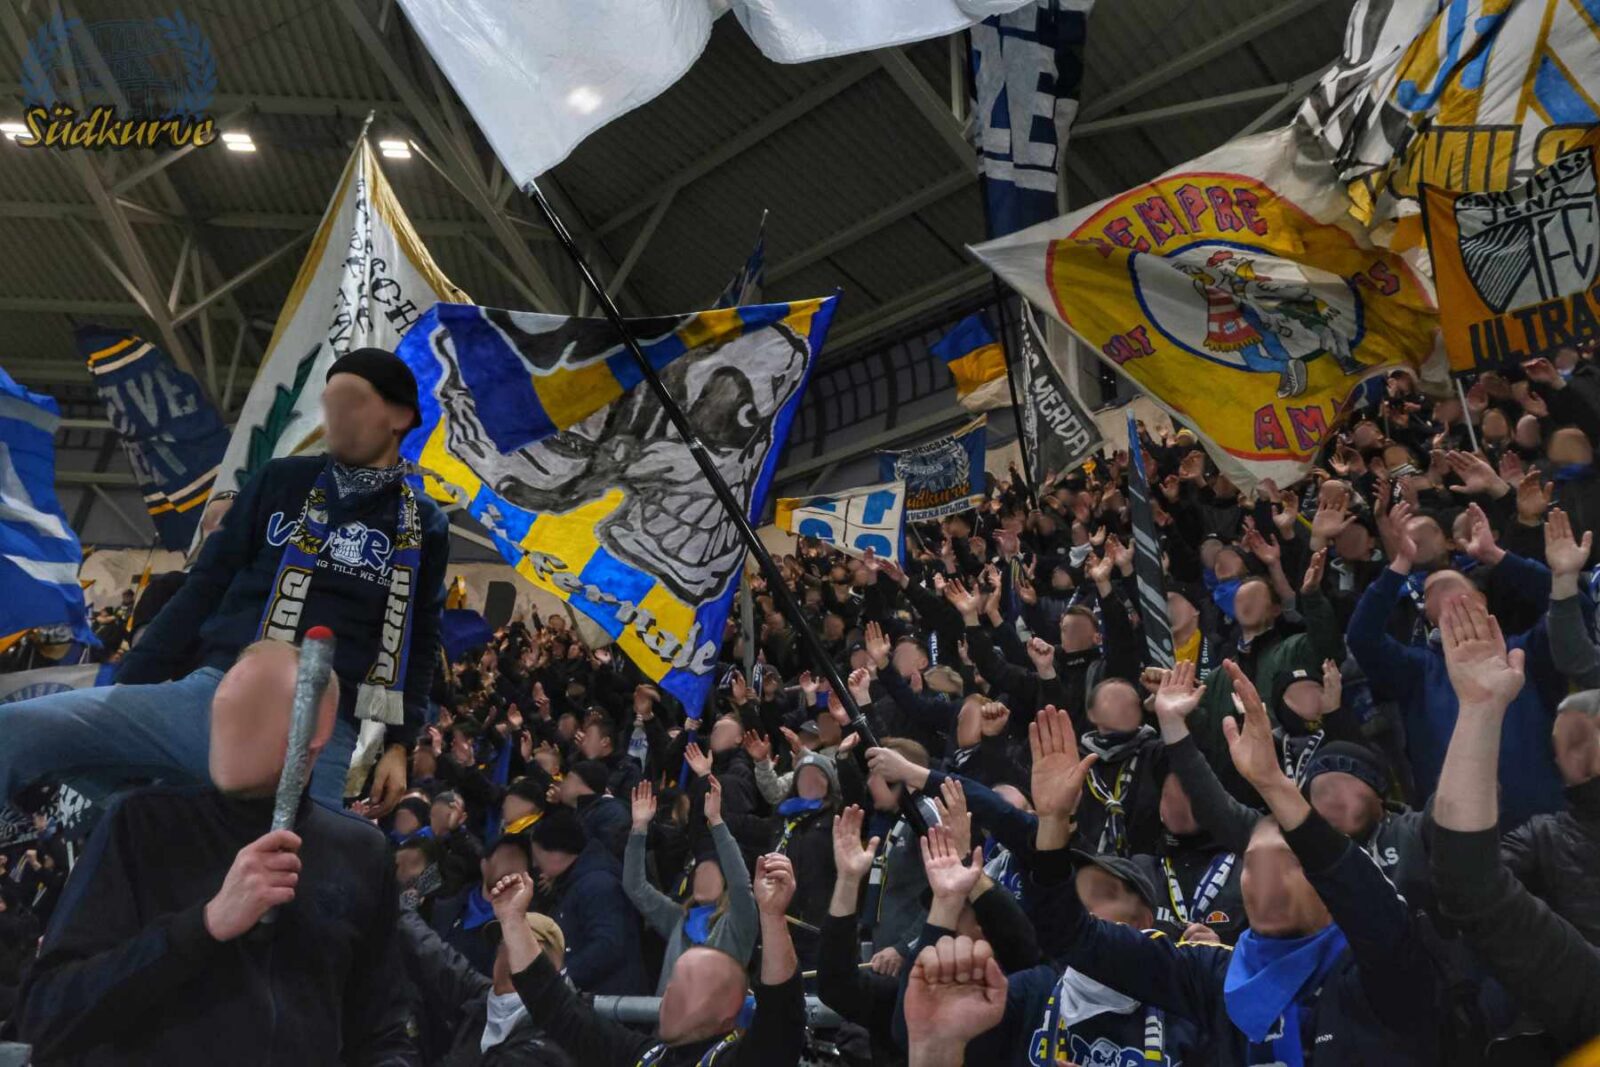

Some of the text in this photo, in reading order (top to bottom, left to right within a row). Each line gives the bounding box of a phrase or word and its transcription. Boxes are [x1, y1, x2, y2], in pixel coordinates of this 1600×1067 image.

[1482, 186, 1569, 227] JENA
[1468, 285, 1600, 371] ULTRA
[1034, 374, 1090, 457] MERDA
[332, 563, 357, 576] TILL
[360, 569, 376, 582] WE
